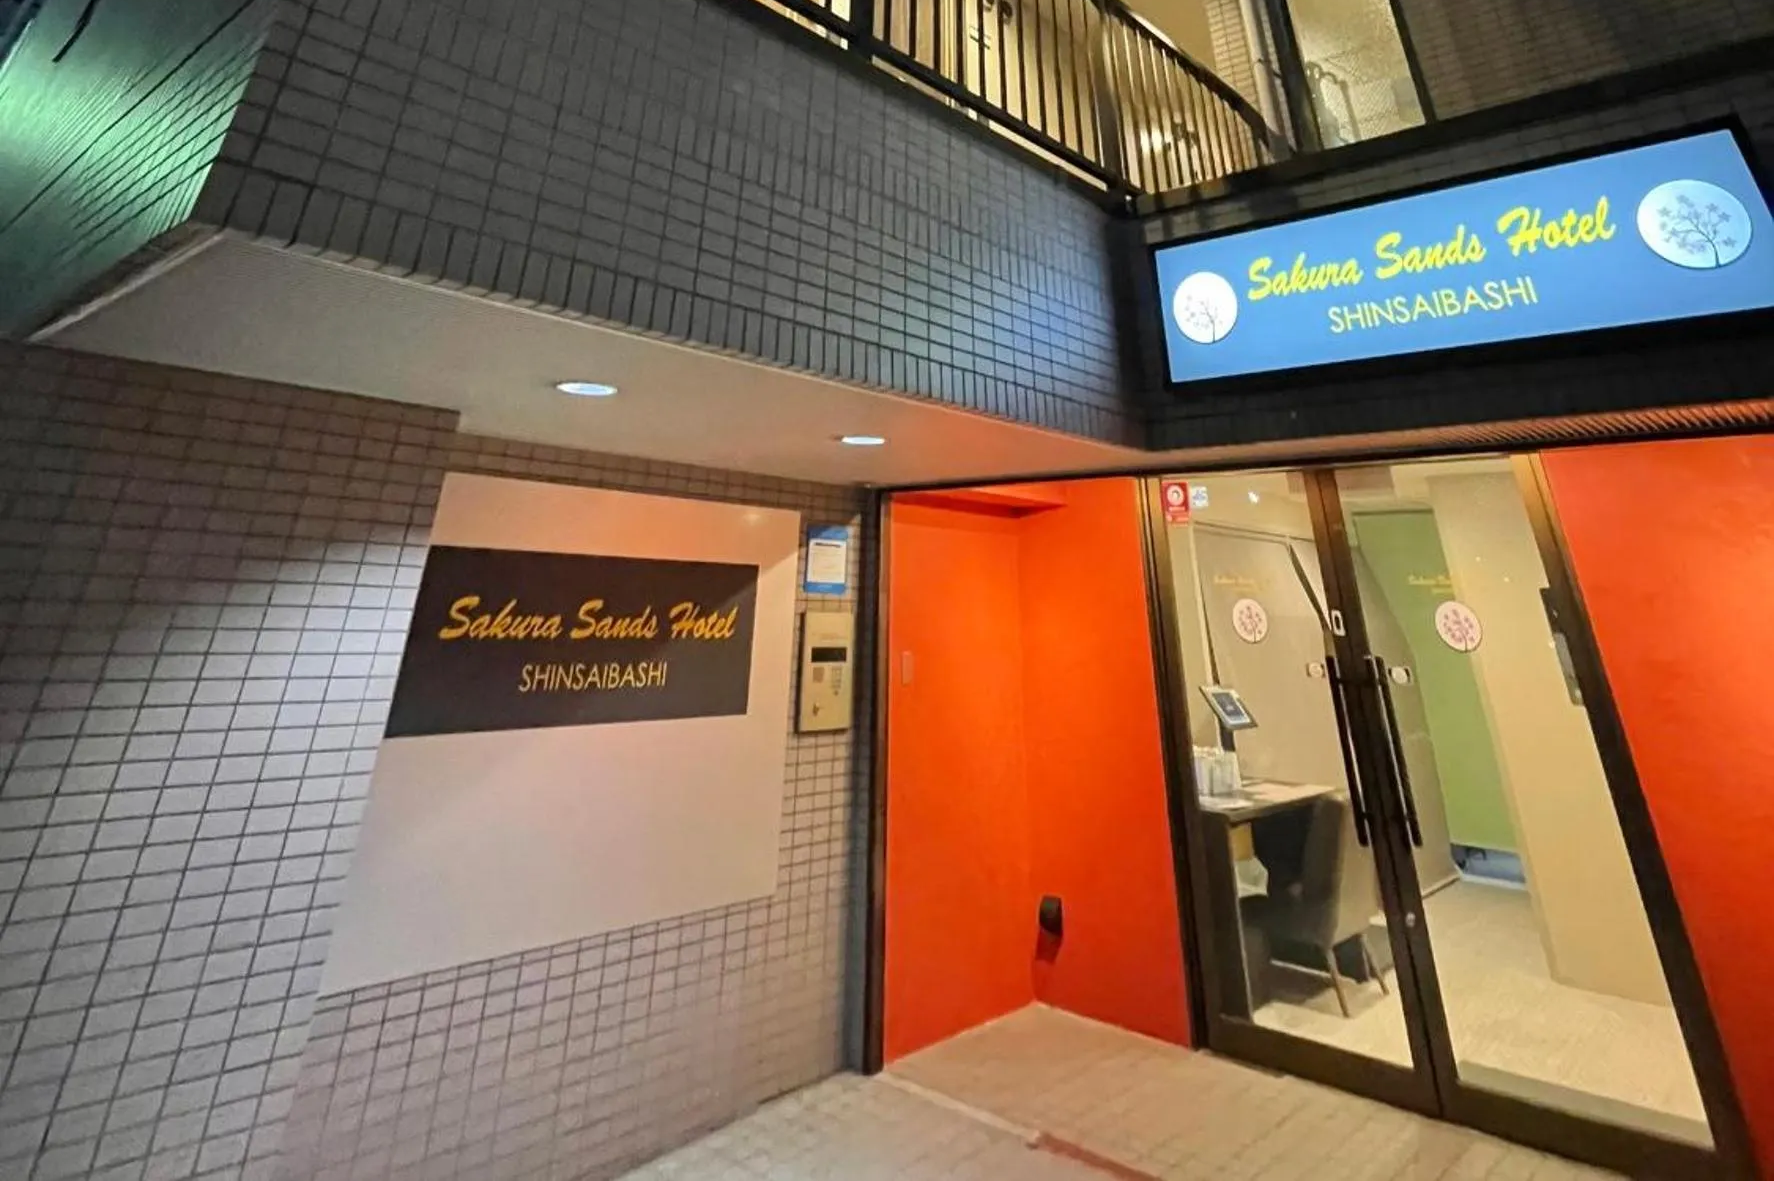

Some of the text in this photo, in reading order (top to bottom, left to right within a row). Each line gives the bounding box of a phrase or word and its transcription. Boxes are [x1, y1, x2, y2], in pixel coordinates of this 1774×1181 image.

[1247, 195, 1616, 301] Sakura Sands Hotel
[1328, 276, 1538, 333] SHINSAIBASHI
[438, 595, 738, 640] Sakura Sands Hotel
[517, 660, 668, 693] SHINSAIBASHI
